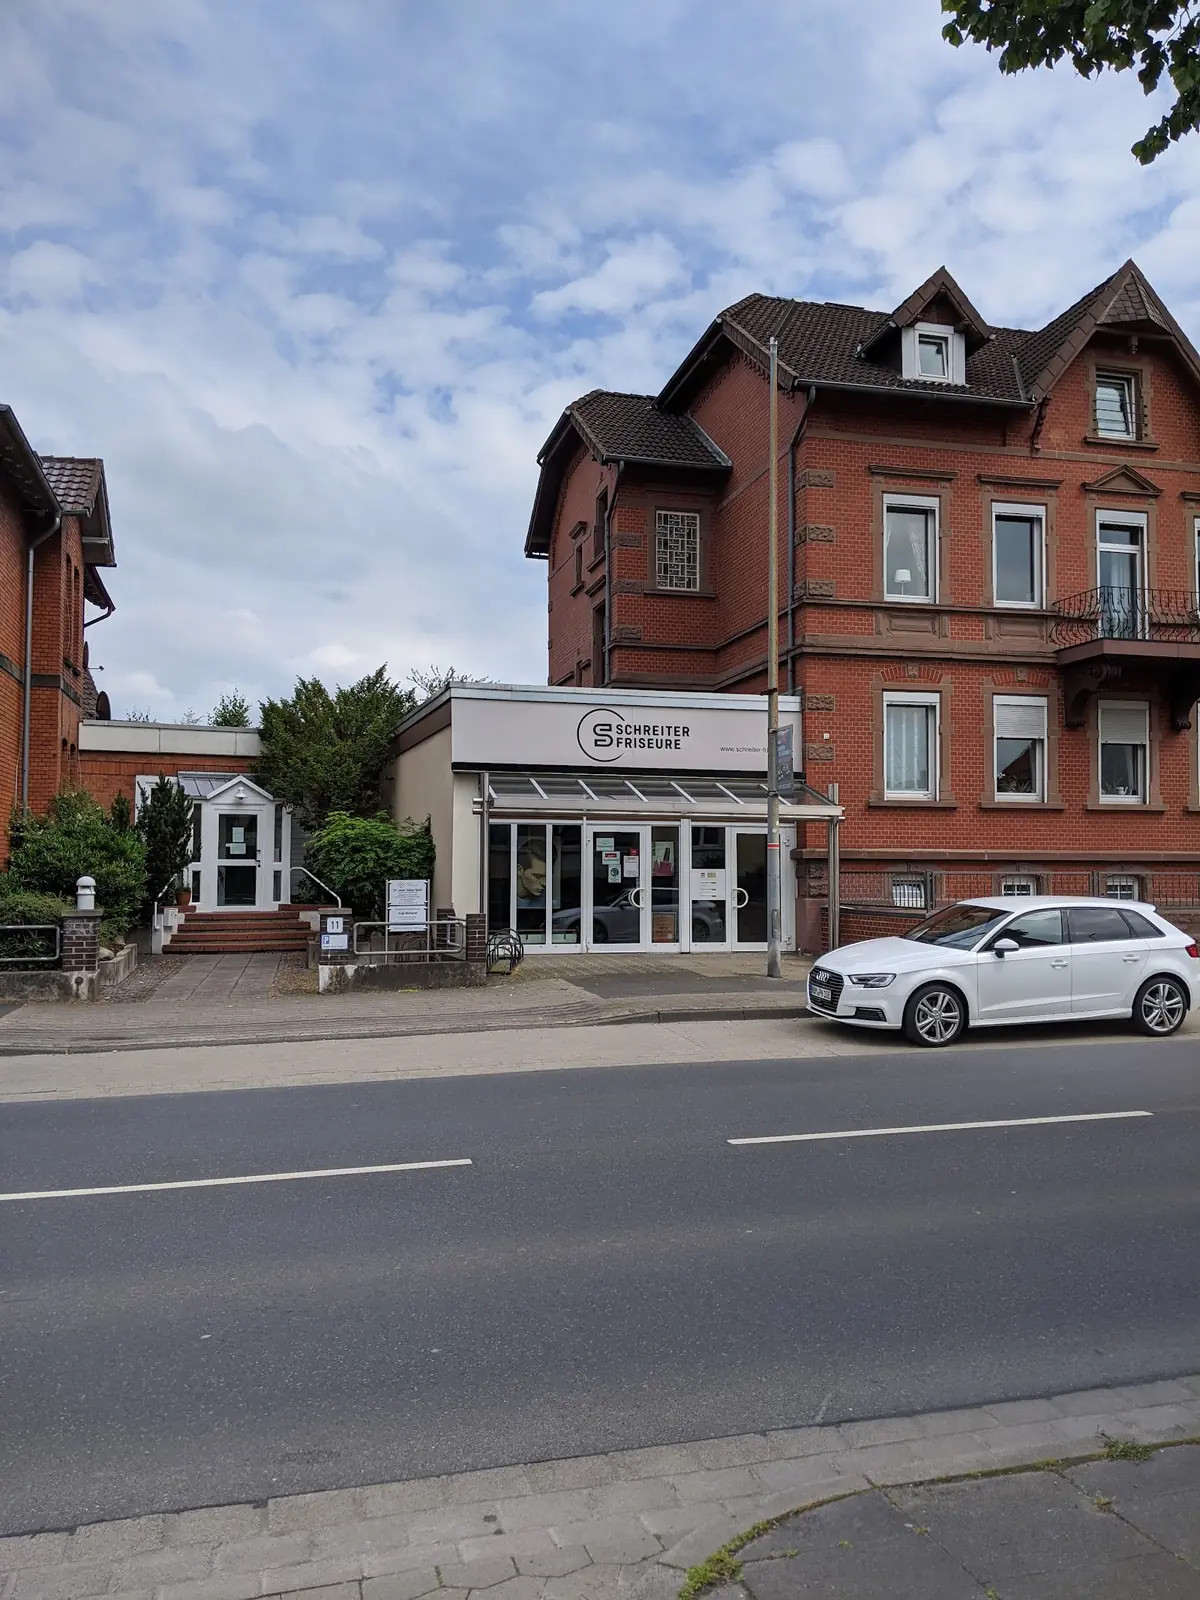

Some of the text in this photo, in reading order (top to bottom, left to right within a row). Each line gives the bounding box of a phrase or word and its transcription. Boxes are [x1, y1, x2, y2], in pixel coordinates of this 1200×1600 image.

[616, 724, 690, 737] SCHREITER
[616, 737, 681, 750] FRISEURE
[719, 745, 769, 753] www.schreiter-fri
[331, 920, 339, 930] 11
[324, 936, 330, 945] P
